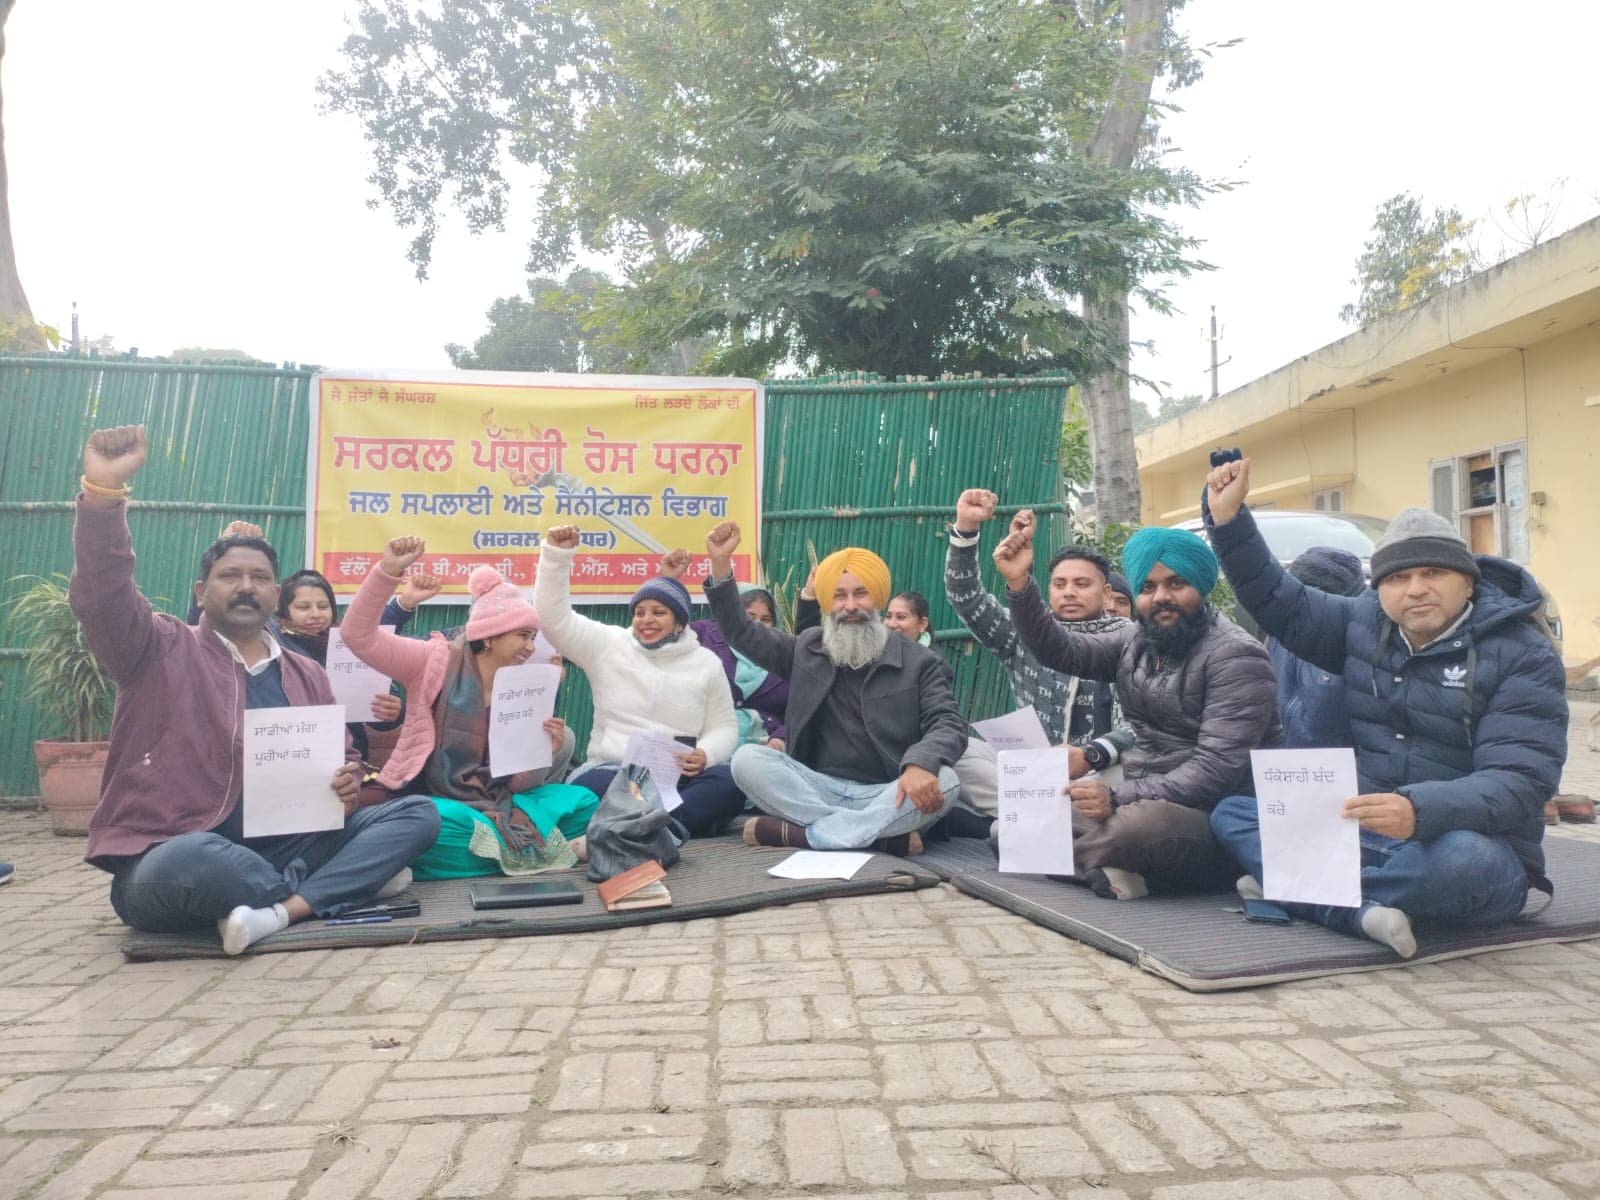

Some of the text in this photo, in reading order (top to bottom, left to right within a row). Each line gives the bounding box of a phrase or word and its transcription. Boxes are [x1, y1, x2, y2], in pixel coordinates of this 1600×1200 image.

[330, 386, 341, 402] ਜੈ
[379, 387, 389, 402] ਜੈ
[727, 396, 740, 410] ਦੀ
[333, 427, 742, 476] ਸਰਕਲ ਪੱਧਰੀ ਰੋਸ ਧਰਨਾ
[349, 491, 391, 514] ਜਲ
[400, 485, 494, 516] ਸਪਲਾਈ
[503, 486, 545, 516] ਅਤੇ
[662, 487, 728, 518] ਵਿਭਾਗ
[473, 530, 540, 550] (ਸਰਕਲ
[621, 557, 649, 577] ਅਤੇ
[1442, 680, 1466, 688] adidas
[1312, 766, 1336, 783] ਬੰਦ
